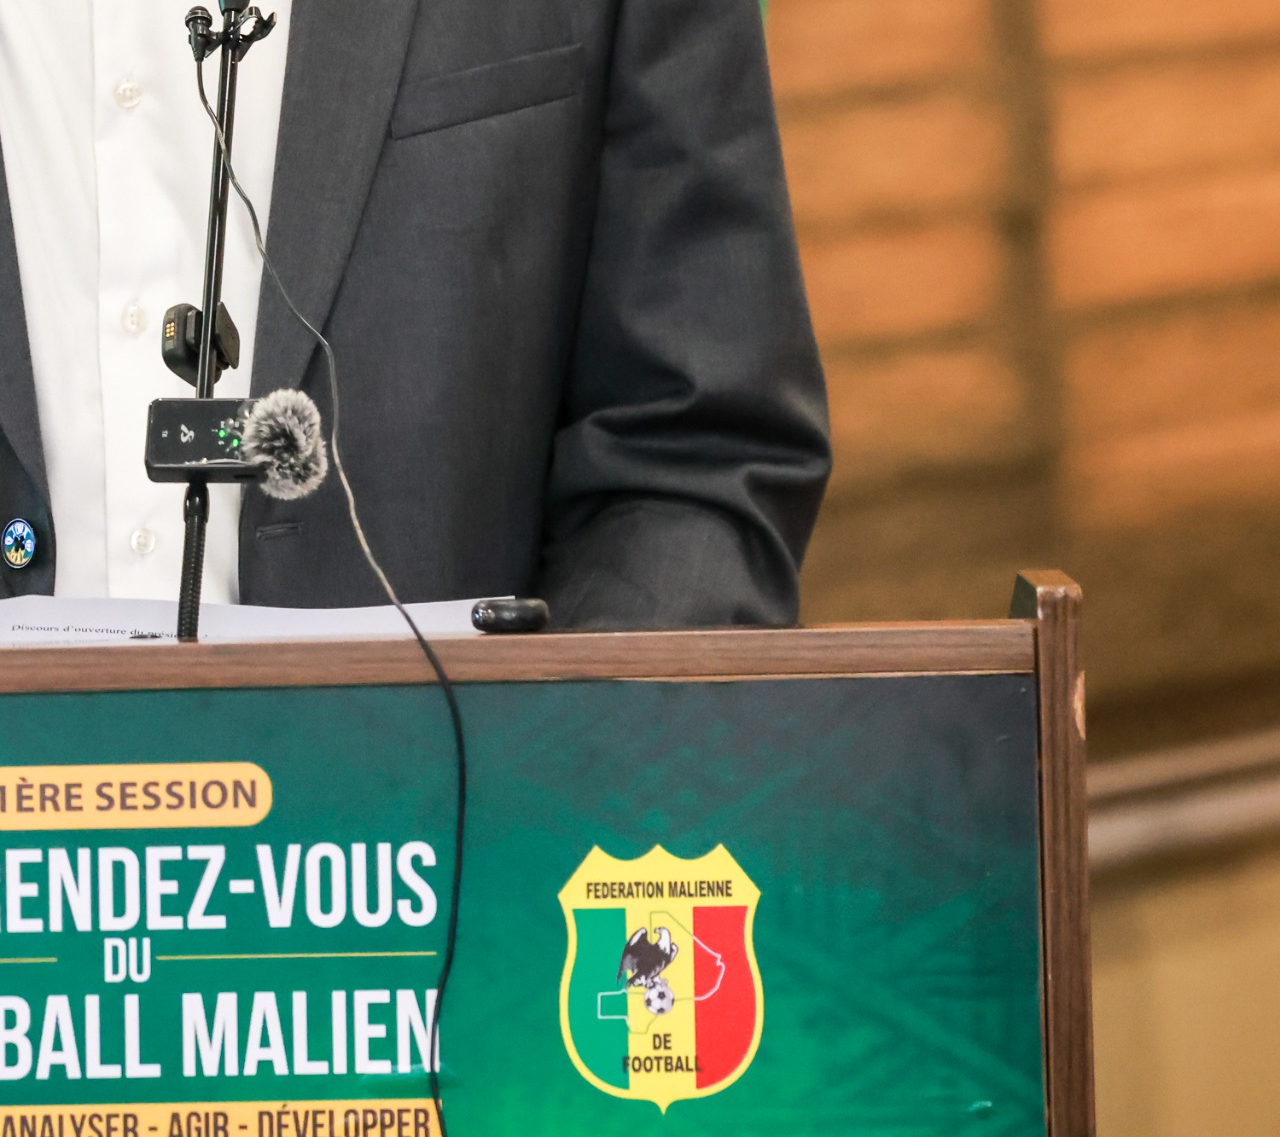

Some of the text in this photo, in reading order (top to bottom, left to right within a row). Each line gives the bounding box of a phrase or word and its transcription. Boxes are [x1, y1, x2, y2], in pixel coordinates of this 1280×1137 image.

[11, 624, 60, 632] Discours
[62, 625, 127, 636] d'ouverture
[147, 630, 179, 639] prési
[95, 779, 258, 812] SESSION
[586, 880, 733, 900] FEDERATION MALIENNE
[103, 936, 152, 984] DU
[182, 989, 441, 1077] MALIEN
[652, 1033, 672, 1050] DE
[622, 1055, 702, 1074] FOOTBALL
[1, 1113, 139, 1137] ANALYSER
[168, 1112, 229, 1137] AGIR
[257, 1104, 430, 1137] DÉVELOPPER
